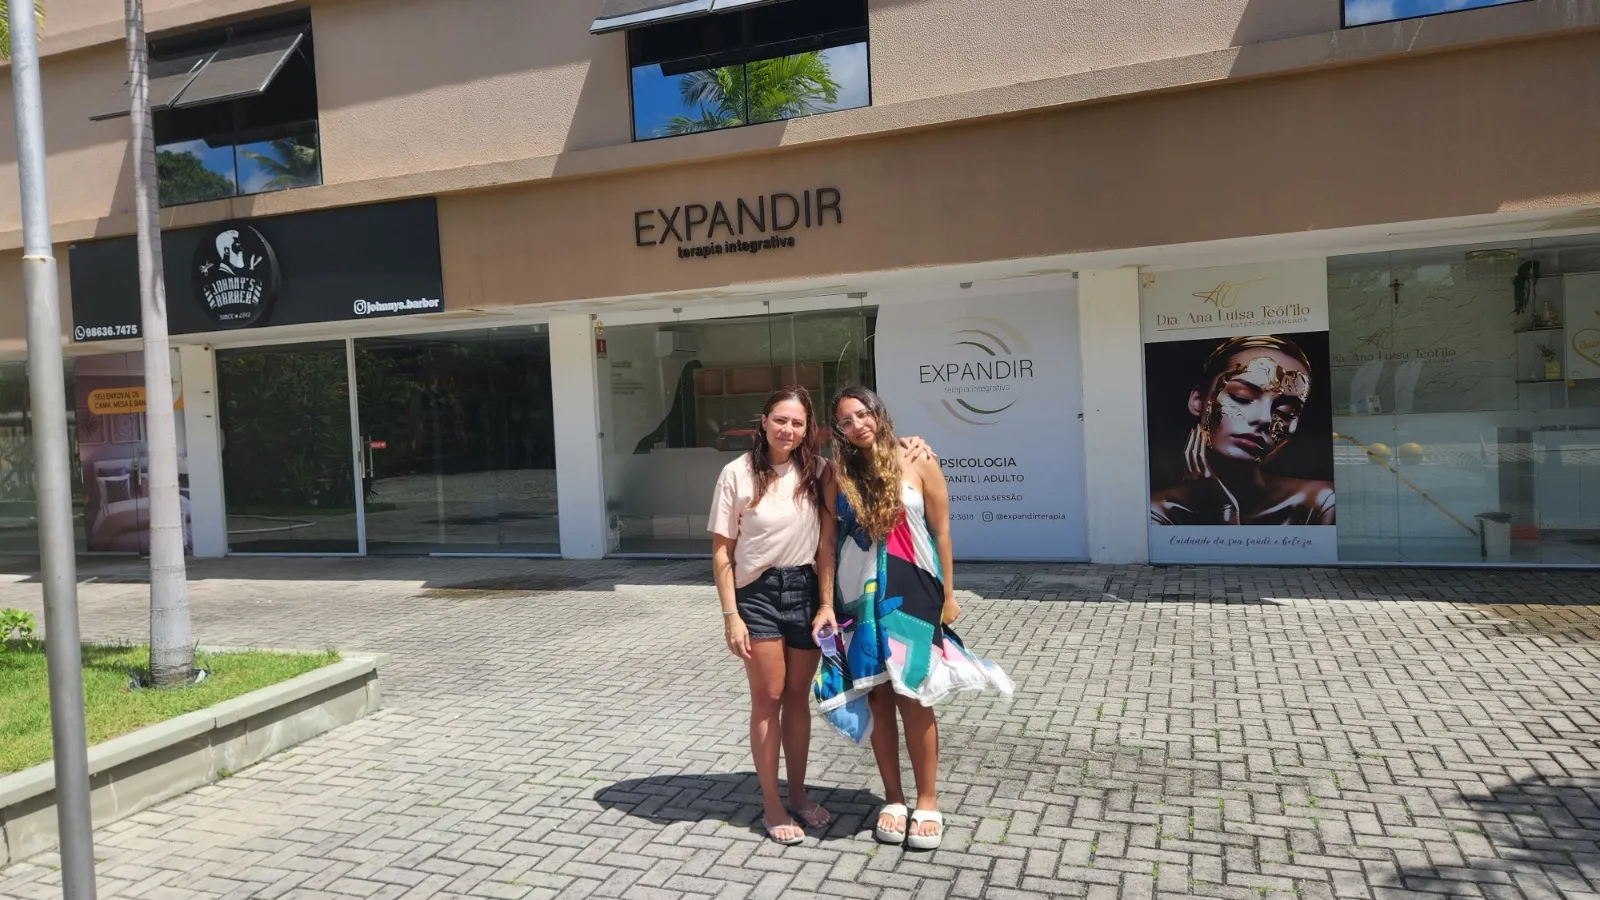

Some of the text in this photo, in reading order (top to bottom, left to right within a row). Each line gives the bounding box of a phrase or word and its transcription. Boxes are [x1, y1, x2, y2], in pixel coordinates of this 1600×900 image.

[634, 187, 842, 247] EXPANDIR
[677, 235, 795, 258] terapia integrativa
[215, 290, 252, 308] BARBER
[366, 297, 440, 314] johnnys.barber
[1157, 313, 1181, 327] Dra.
[1186, 312, 1213, 324] Ana
[1261, 303, 1311, 319] Teófilo
[85, 324, 138, 338] 98636.7475
[919, 359, 1034, 384] EXPANDIR
[94, 392, 106, 400] SEU
[131, 390, 140, 399] DE
[944, 383, 1011, 395] terapia integrativa
[113, 401, 129, 409] MESA
[134, 399, 146, 407] BAN
[939, 457, 1017, 469] PSICOLOGIA
[944, 474, 1025, 484] FANTIL ADULTO
[973, 494, 990, 502] SUA
[991, 493, 1023, 502] SESSÃO
[949, 512, 1066, 521] 2-3818 @expandirterapia
[1169, 535, 1211, 546] Cuidando
[1213, 536, 1225, 545] da
[1282, 536, 1313, 549] beleza
